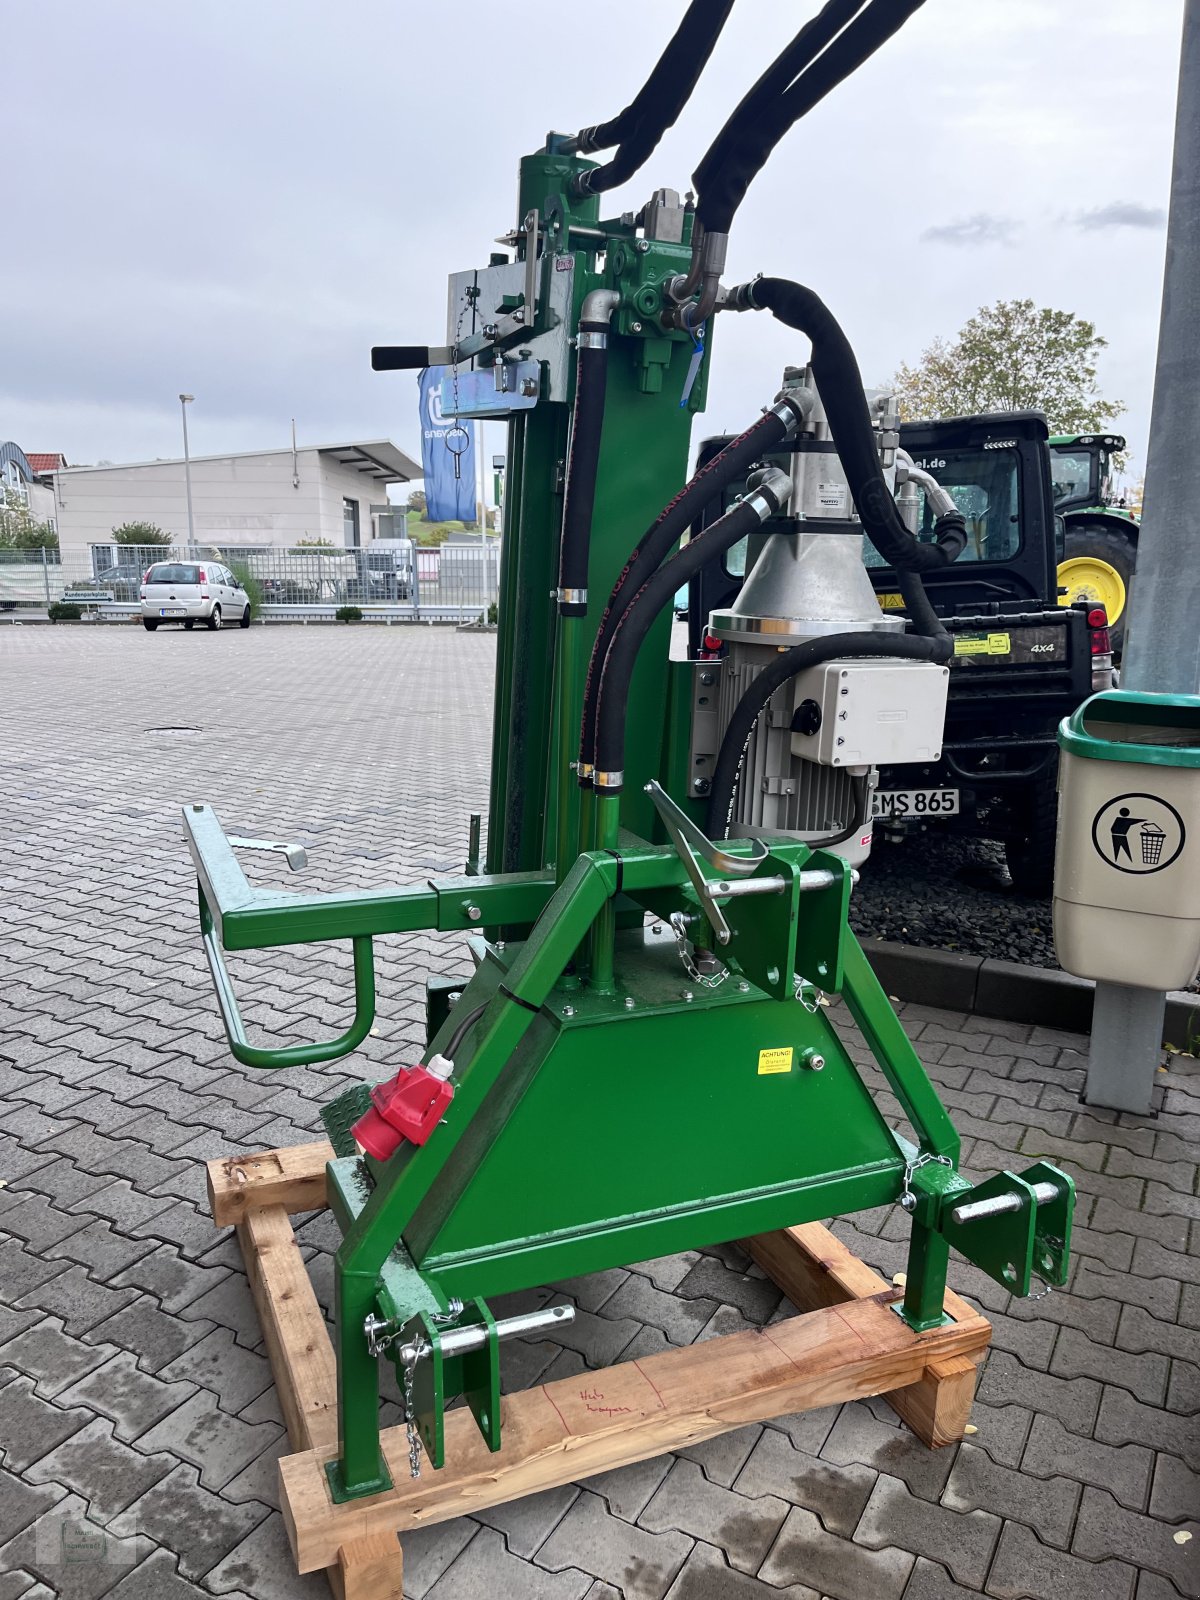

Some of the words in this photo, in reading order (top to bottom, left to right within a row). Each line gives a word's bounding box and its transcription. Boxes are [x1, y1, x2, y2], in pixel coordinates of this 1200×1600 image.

[881, 793, 910, 814] MS
[914, 791, 955, 813] 865
[761, 1050, 791, 1058] ACHTUNG!
